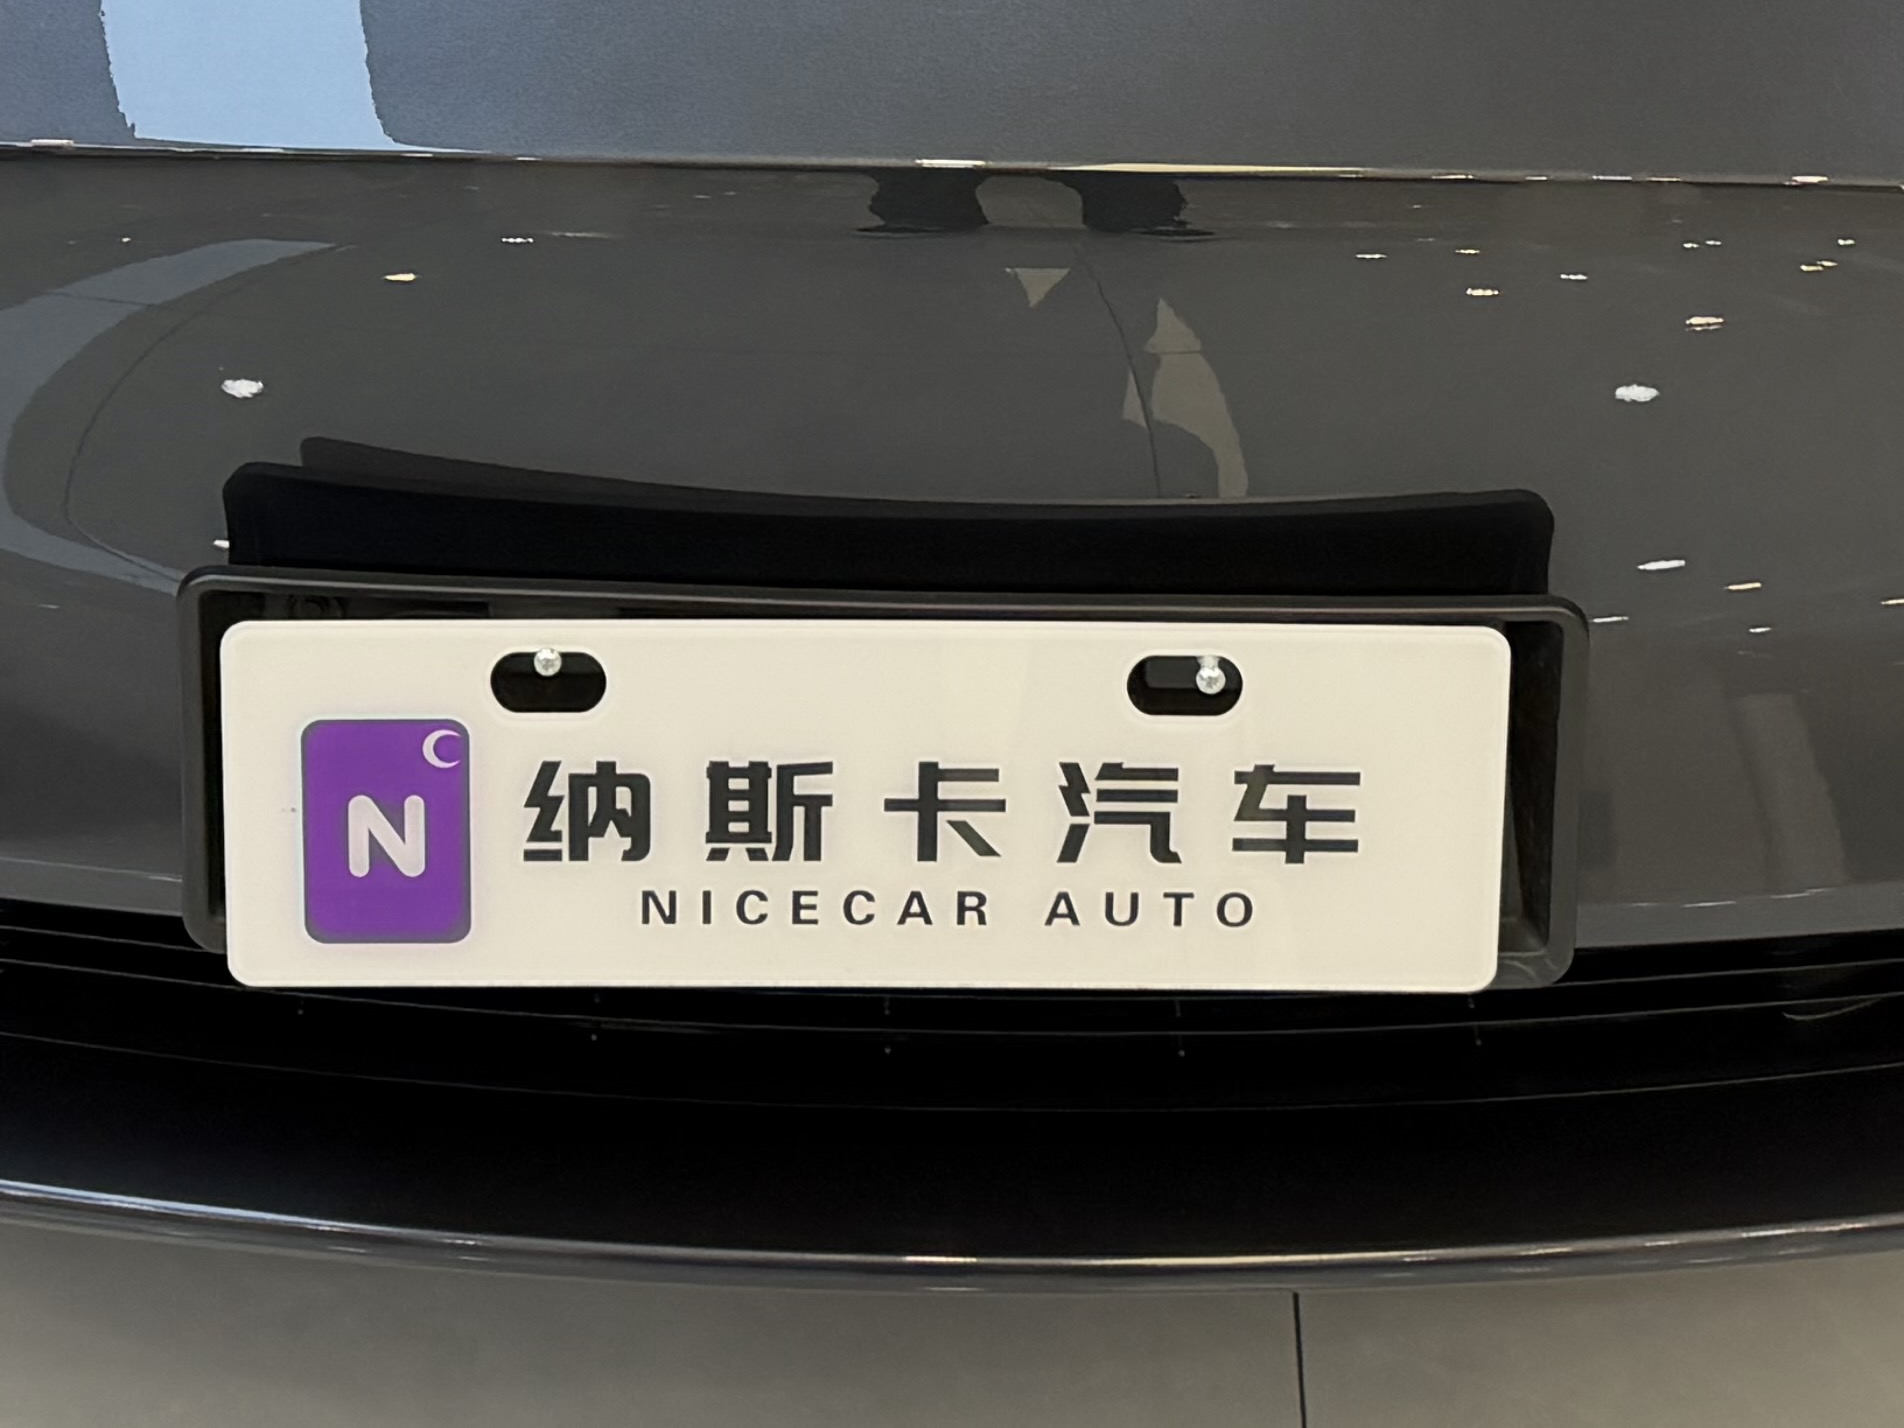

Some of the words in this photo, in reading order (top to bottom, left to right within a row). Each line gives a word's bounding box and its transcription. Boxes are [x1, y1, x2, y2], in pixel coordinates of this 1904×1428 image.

[347, 794, 426, 878] N
[523, 760, 1362, 865] 纳斯卡汽车
[640, 889, 989, 927] NICECAR
[1044, 890, 1255, 928] AUTO
